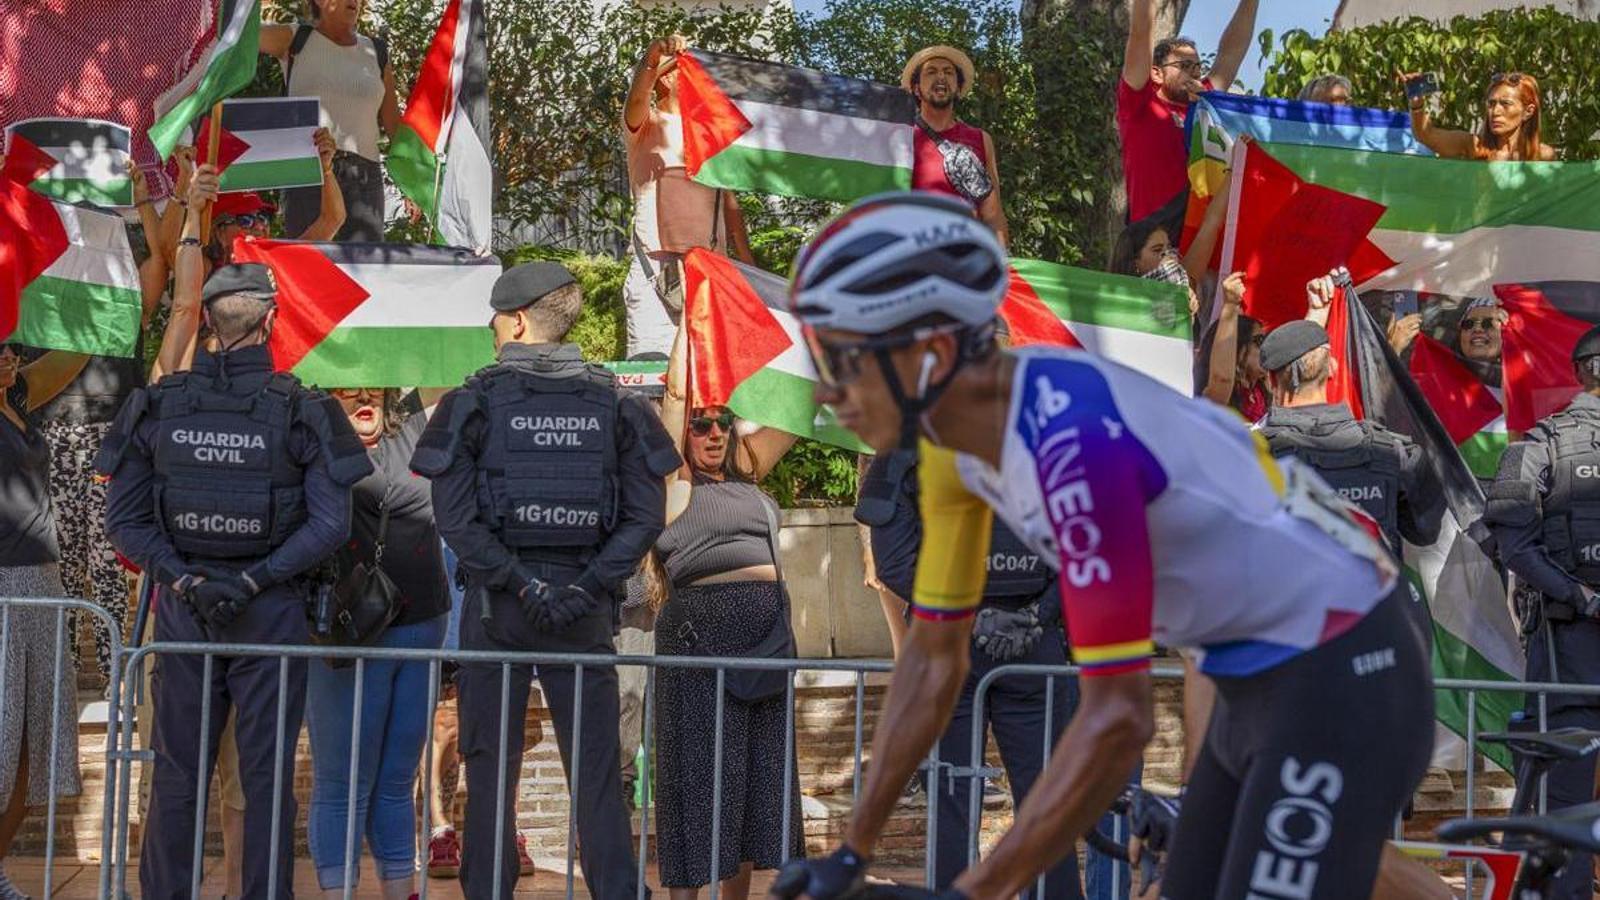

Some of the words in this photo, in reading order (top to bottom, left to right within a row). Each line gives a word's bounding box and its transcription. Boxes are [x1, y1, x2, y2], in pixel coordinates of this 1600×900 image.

[510, 416, 601, 431] GUARDIA
[171, 429, 266, 449] GUARDIA
[533, 432, 582, 446] CIVIL
[194, 447, 246, 463] CIVIL
[515, 504, 599, 526] 1G1C076
[1037, 426, 1112, 588] INEOS
[174, 512, 262, 534] 1G1C066
[1246, 756, 1344, 900] EOS
